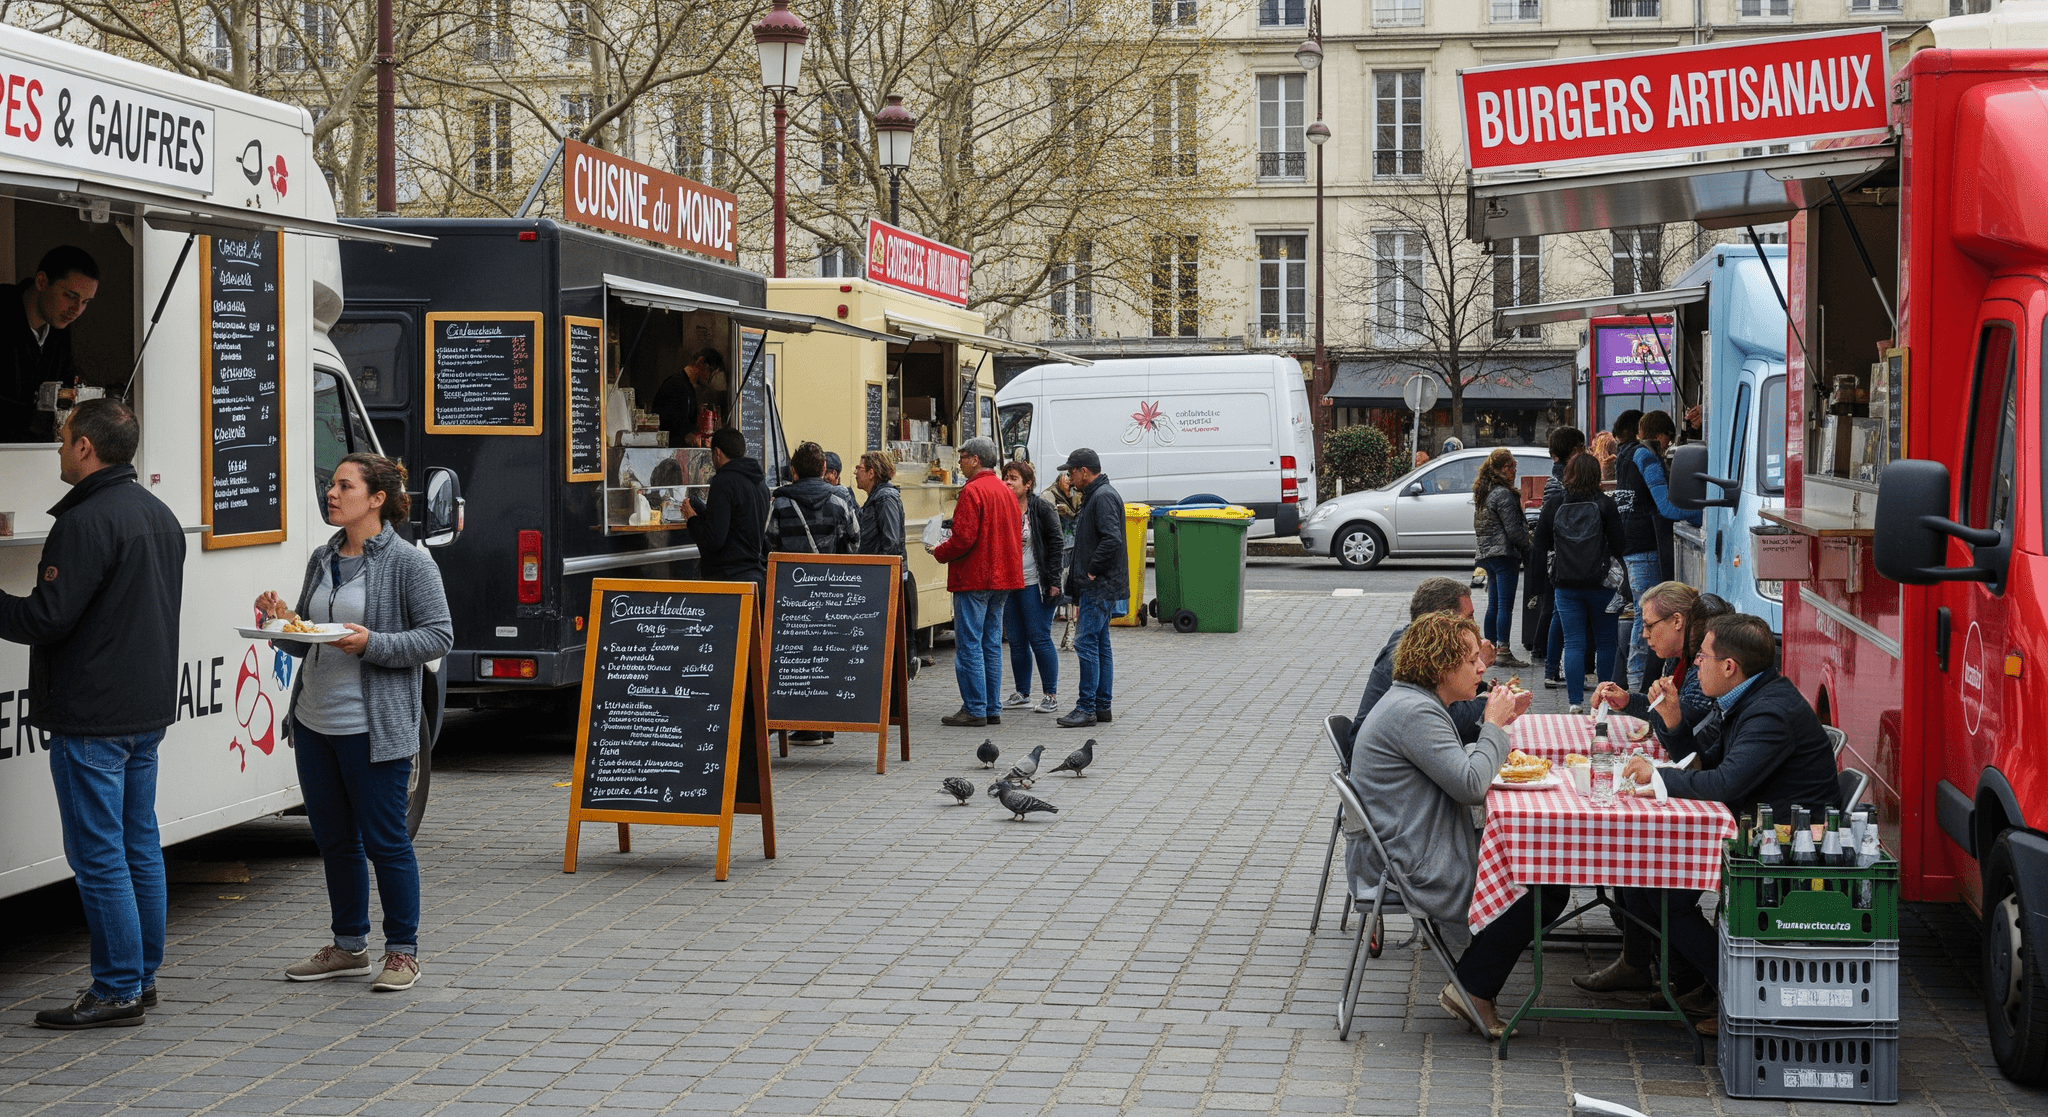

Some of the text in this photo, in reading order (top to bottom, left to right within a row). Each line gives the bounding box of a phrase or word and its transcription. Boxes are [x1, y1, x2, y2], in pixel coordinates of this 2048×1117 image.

[0, 73, 205, 175] ES & GAUFRES
[1477, 54, 1875, 149] BURGERS ARTISANAUX
[574, 153, 734, 252] CUISINE du MONDE
